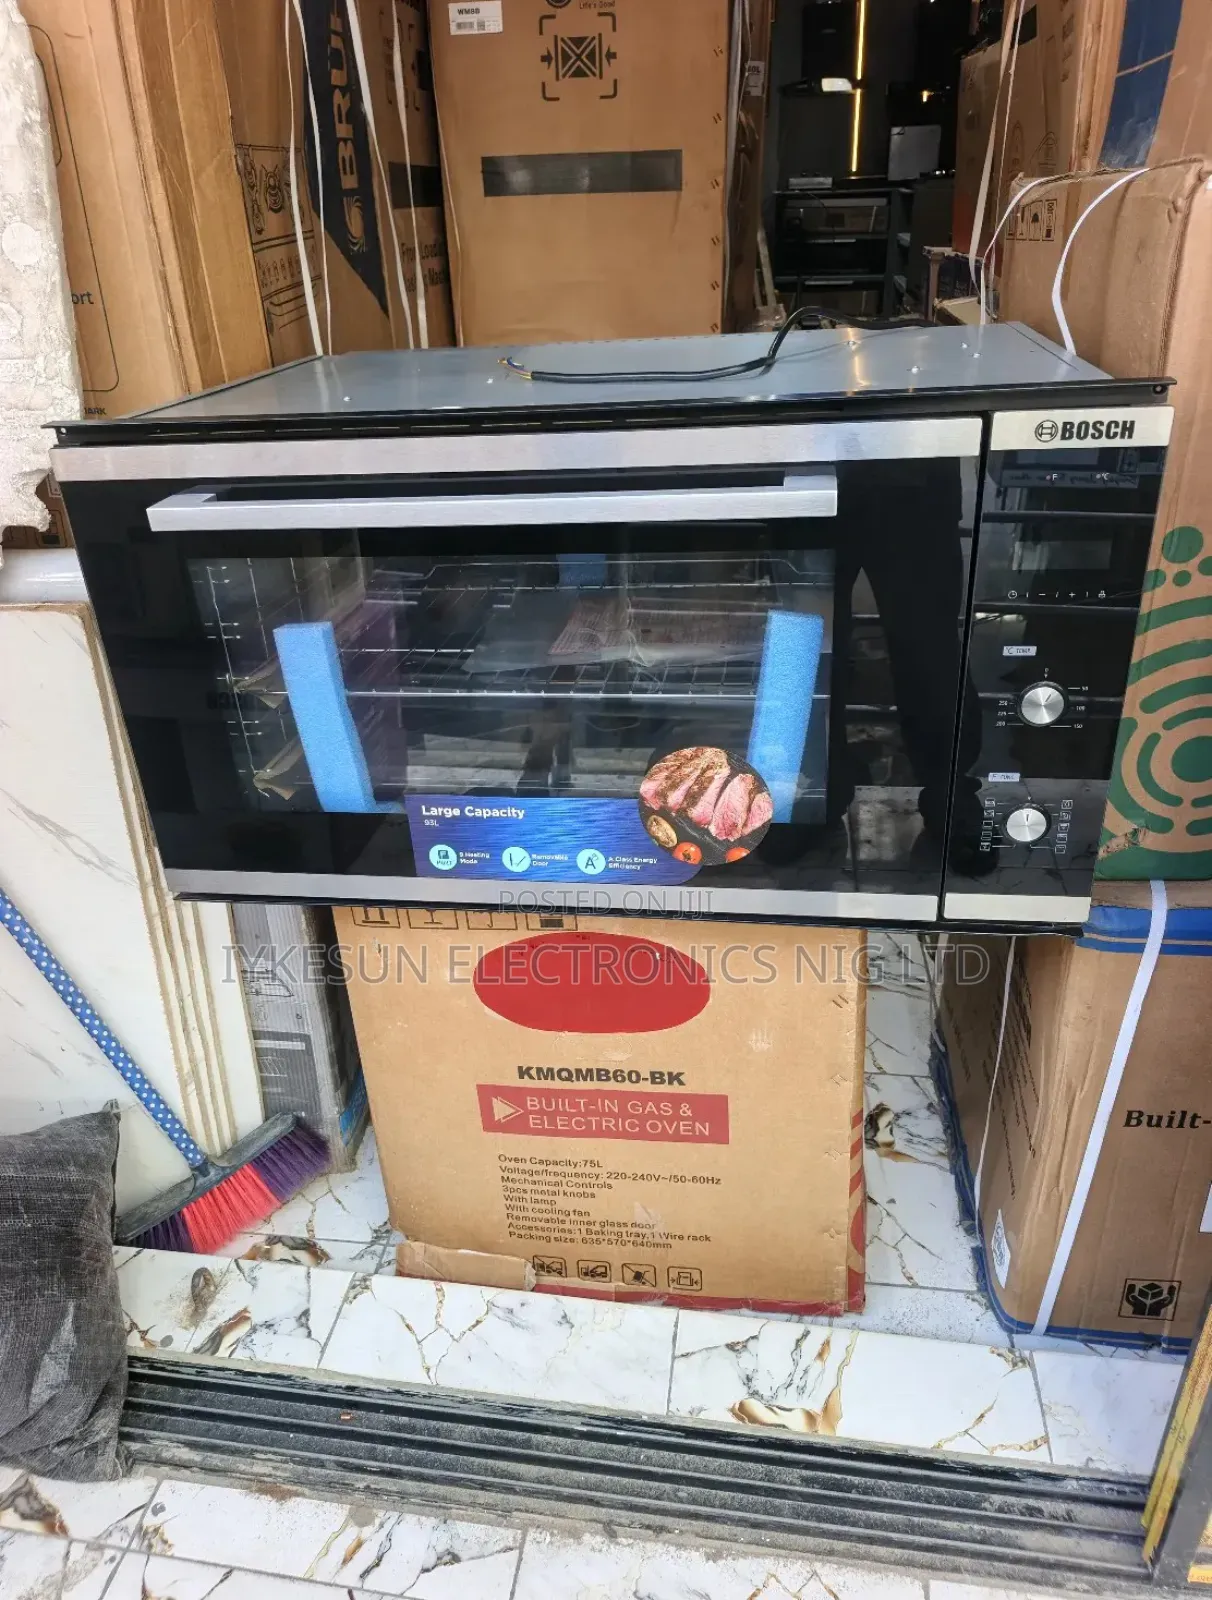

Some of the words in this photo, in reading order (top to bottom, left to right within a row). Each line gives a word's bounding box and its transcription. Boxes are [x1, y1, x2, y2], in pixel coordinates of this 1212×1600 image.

[1060, 420, 1136, 441] BOSCH
[421, 805, 461, 818] Large
[464, 806, 525, 820] Capacity
[424, 819, 439, 827] 93L
[517, 1065, 686, 1086] KMQMB60-BK
[526, 1096, 619, 1114] BUILT-IN
[627, 1100, 673, 1117] GAS
[679, 1102, 693, 1117] &
[528, 1114, 641, 1133] ELECTRIC
[645, 1119, 711, 1137] OVEN
[1122, 1109, 1212, 1129] Built-
[498, 1153, 528, 1164] Oven
[529, 1156, 604, 1169] Capacity:75L
[500, 1175, 564, 1188] Mechanical
[565, 1179, 614, 1190] Controls
[501, 1184, 528, 1195] 3pcs
[530, 1187, 560, 1197] metal
[562, 1190, 596, 1199] knobs
[503, 1194, 528, 1204] With
[530, 1196, 557, 1206] lamp
[504, 1203, 529, 1213] With
[531, 1206, 571, 1217] cooling
[572, 1208, 591, 1217] fan
[506, 1212, 567, 1225] Removable
[569, 1218, 597, 1227] inner
[598, 1219, 629, 1229] glass
[630, 1220, 657, 1230] door
[508, 1230, 552, 1243] Packing
[553, 1236, 580, 1244] size:
[585, 1227, 624, 1239] Baking
[659, 1231, 685, 1241] Wire
[687, 1234, 712, 1243] rack
